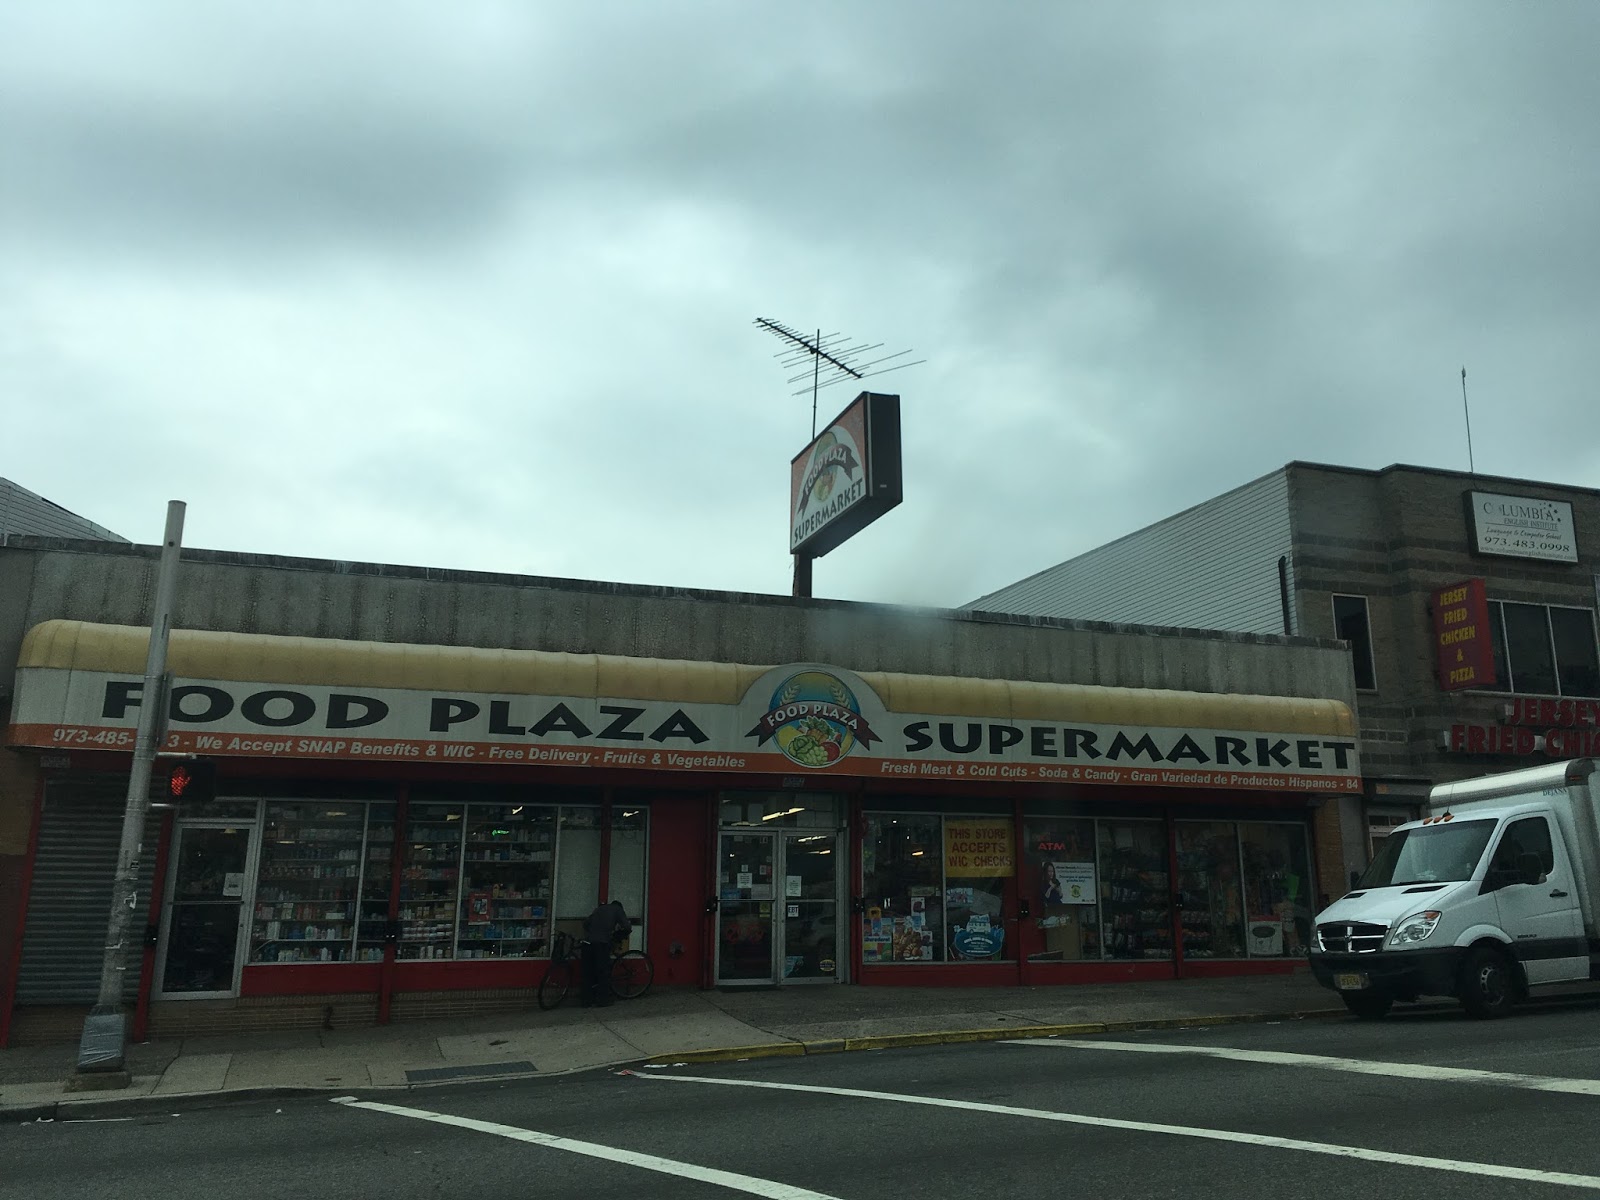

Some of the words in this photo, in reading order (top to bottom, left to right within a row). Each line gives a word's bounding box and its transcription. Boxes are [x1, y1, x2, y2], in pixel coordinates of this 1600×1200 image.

[793, 477, 863, 544] SUPERMARKET
[1483, 502, 1554, 521] CLUMBIA
[1484, 536, 1570, 552] 973.483.0998
[1440, 587, 1468, 606] JERSEY
[1443, 608, 1468, 625] FRIED
[1440, 625, 1475, 646] CHICKEN
[1456, 649, 1464, 662] &
[1450, 666, 1475, 684] PIZZA
[102, 681, 389, 729] FOOD
[429, 697, 711, 744] PLAZA
[903, 721, 1355, 770] SUPERMARKET
[767, 704, 809, 727] FOOD
[813, 704, 858, 730] PLAZA
[1451, 724, 1535, 755] FRIED
[196, 735, 224, 750] We
[227, 737, 292, 755] Accept
[298, 739, 345, 754] SNAP
[350, 740, 420, 757] Benefits
[425, 744, 437, 757] &
[443, 745, 475, 758] WIC
[489, 746, 525, 760] Free
[528, 747, 591, 765] Delivery
[603, 751, 646, 765] Fruits
[651, 753, 662, 765] &
[667, 753, 746, 770] Vegetables
[880, 761, 918, 775] Fresh
[920, 762, 953, 776] Meat
[956, 764, 966, 776] &
[969, 764, 998, 777] Cold
[1000, 765, 1027, 777] Cuts
[1038, 766, 1068, 779] Soda
[1071, 767, 1081, 779] &
[1084, 768, 1120, 783] Candy
[1130, 770, 1158, 784] Gran
[1161, 771, 1210, 786] Variedad
[1213, 773, 1228, 786] de
[1230, 775, 1286, 788] Productos
[1288, 777, 1337, 790] Hispanos
[949, 828, 970, 839] THIS
[975, 828, 1006, 840] STORE
[951, 841, 1006, 853] ACCEPTS
[1038, 842, 1066, 851] ATM
[950, 856, 967, 867] WIC
[974, 856, 1012, 868] CHECKS
